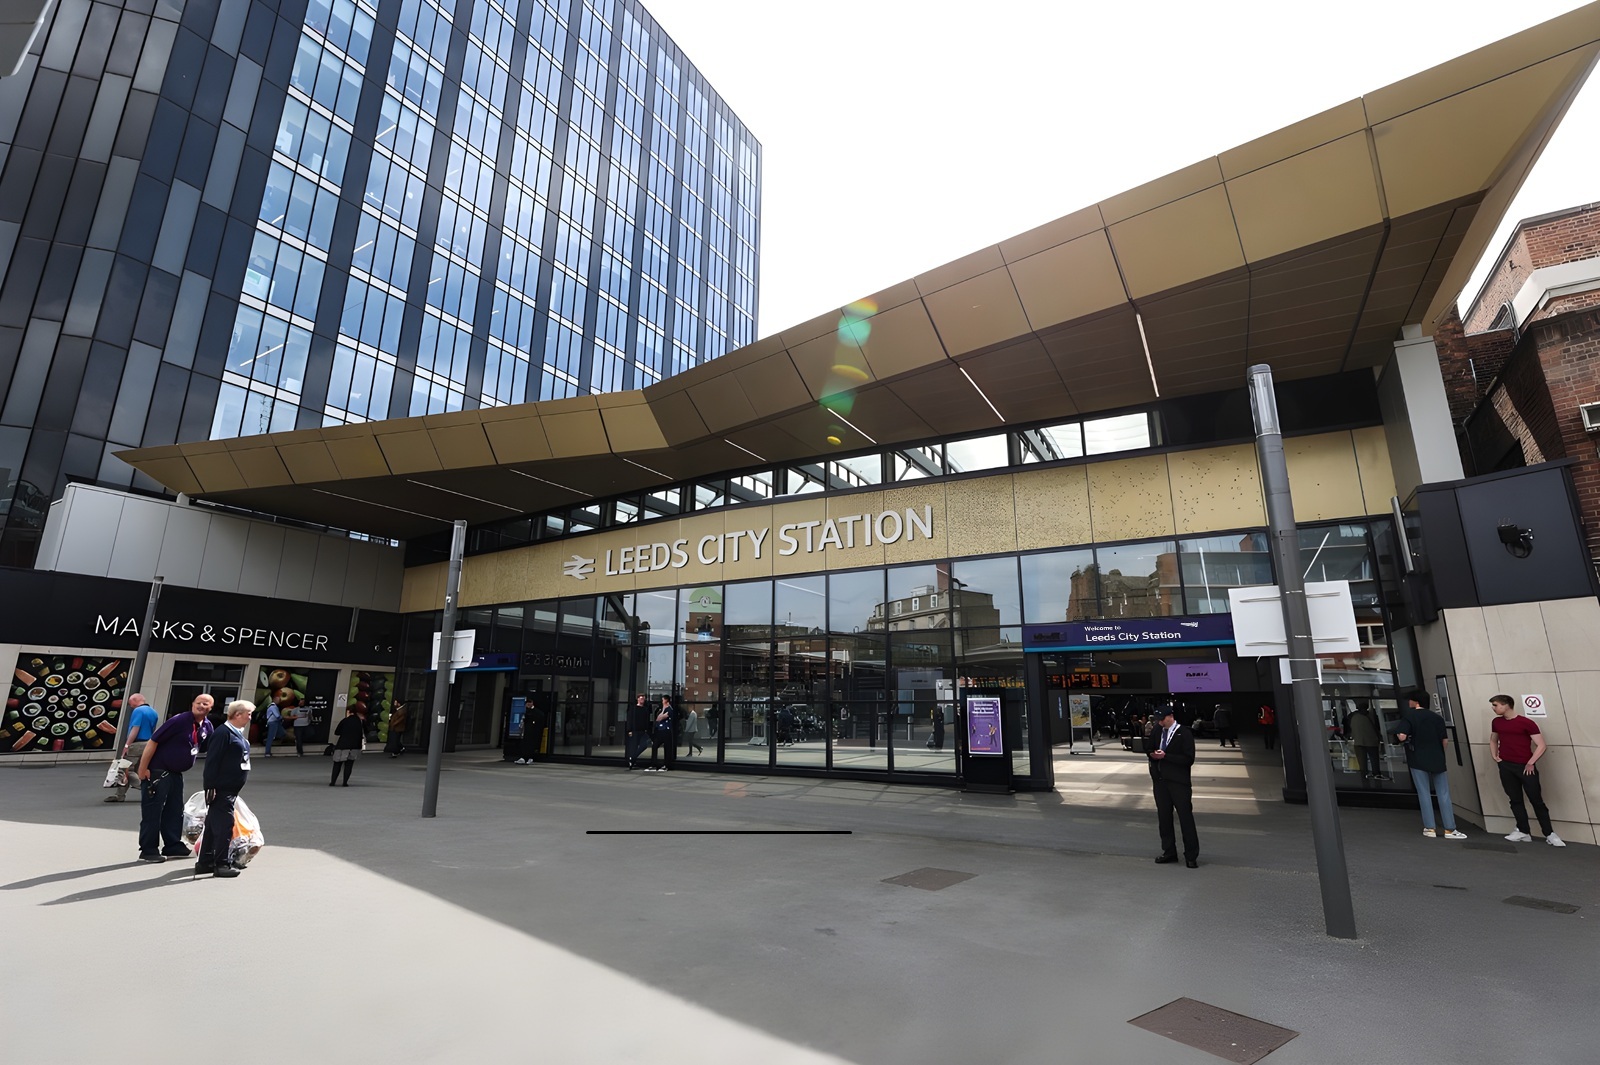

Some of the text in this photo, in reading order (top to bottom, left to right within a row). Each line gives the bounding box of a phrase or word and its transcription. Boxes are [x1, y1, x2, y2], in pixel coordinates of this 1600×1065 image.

[605, 505, 934, 576] LEEDS CITY STATION
[95, 614, 329, 651] MARKS & SPENCER
[1085, 631, 1182, 642] Leeds City Station
